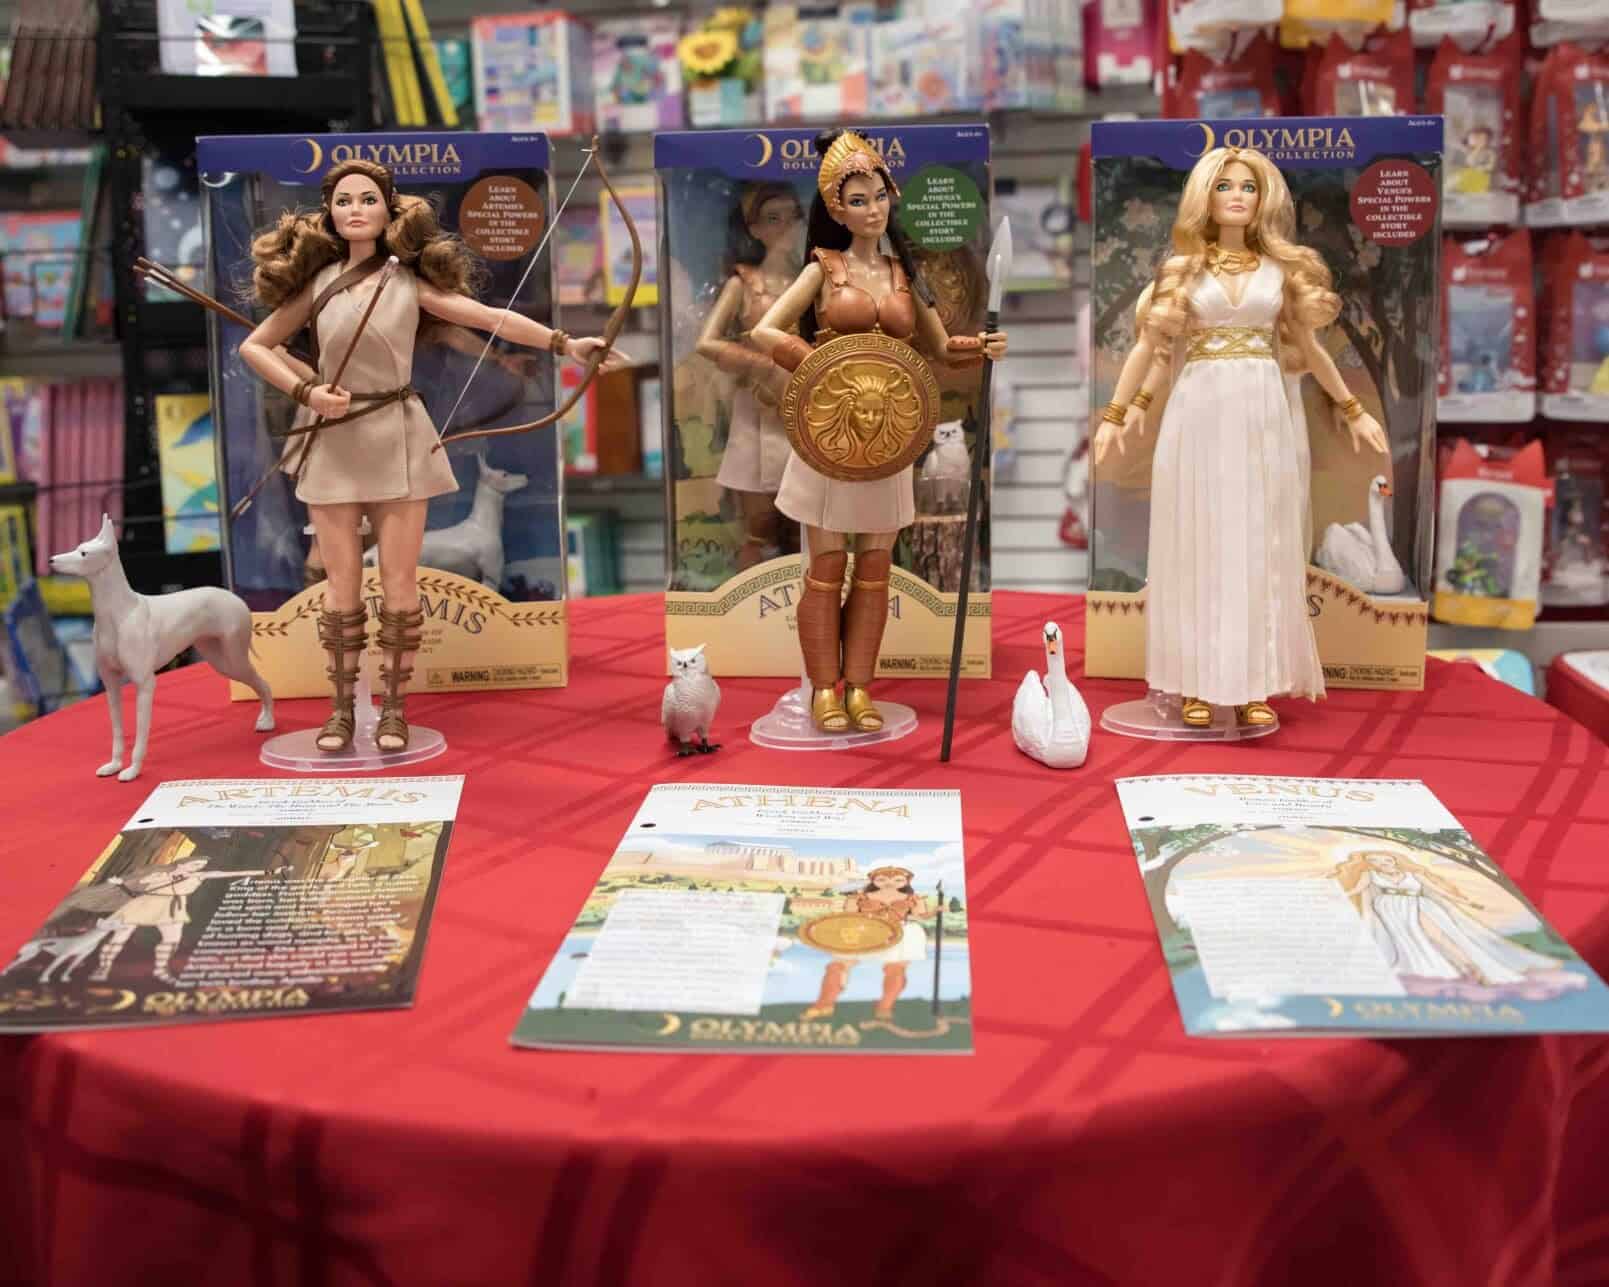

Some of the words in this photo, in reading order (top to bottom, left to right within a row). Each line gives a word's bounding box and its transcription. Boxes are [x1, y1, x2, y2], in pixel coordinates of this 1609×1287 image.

[1223, 127, 1356, 149] OLYMPIA
[331, 142, 461, 164] OLYMPIA
[783, 161, 817, 170] DOLL
[394, 164, 461, 176] LLECTION
[1380, 170, 1409, 178] LEARN
[1358, 196, 1393, 204] SPECIAL
[1396, 196, 1432, 204] POWERS
[907, 203, 940, 211] SPECIAL
[468, 211, 501, 219] SPECIAL
[1366, 213, 1423, 221] COLLECTIBLE
[915, 219, 969, 227] COLLECTIBLE
[1381, 222, 1408, 230] STORY
[476, 228, 530, 236] COLLECTIBLE
[1373, 231, 1416, 239] INCLUDED
[178, 784, 427, 809] ARTEMIS
[1183, 783, 1376, 802] VENUS
[692, 795, 911, 818] ATHENA
